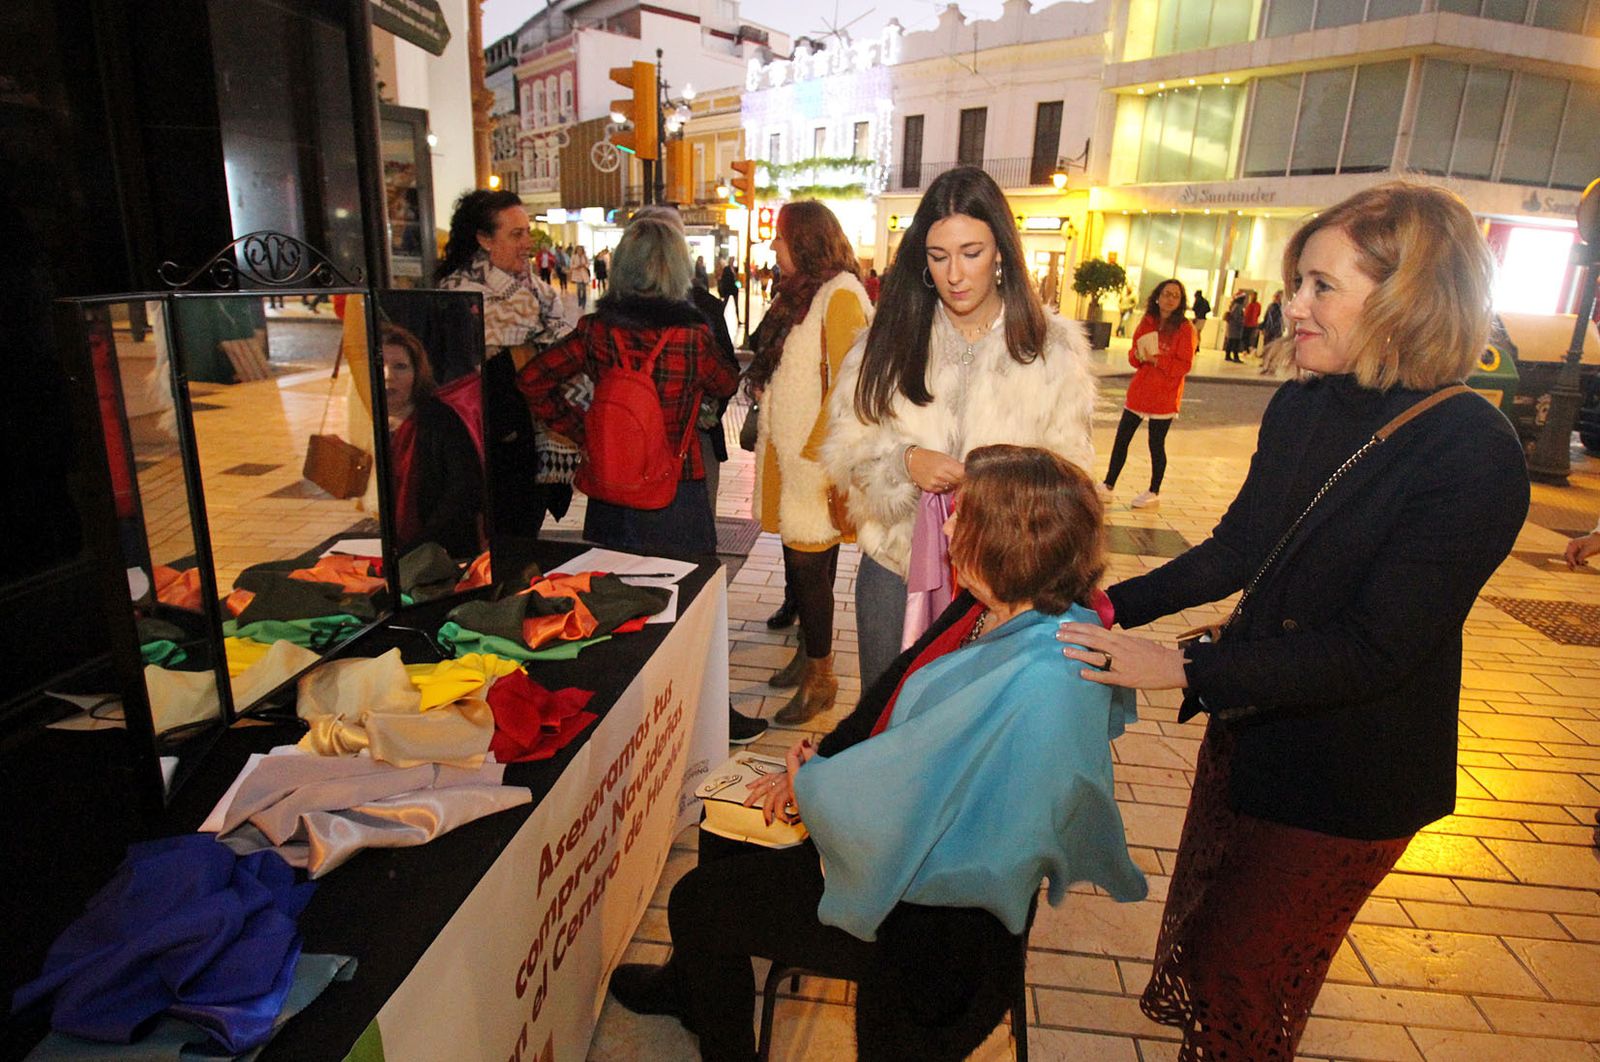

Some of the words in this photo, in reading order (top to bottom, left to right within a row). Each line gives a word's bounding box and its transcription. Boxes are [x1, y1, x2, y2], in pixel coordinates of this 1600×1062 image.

[537, 712, 650, 899] Asesoramos
[653, 679, 673, 724] tus
[515, 826, 607, 999] compras
[532, 960, 548, 1022] el
[552, 851, 620, 971] Centro
[624, 810, 643, 854] de
